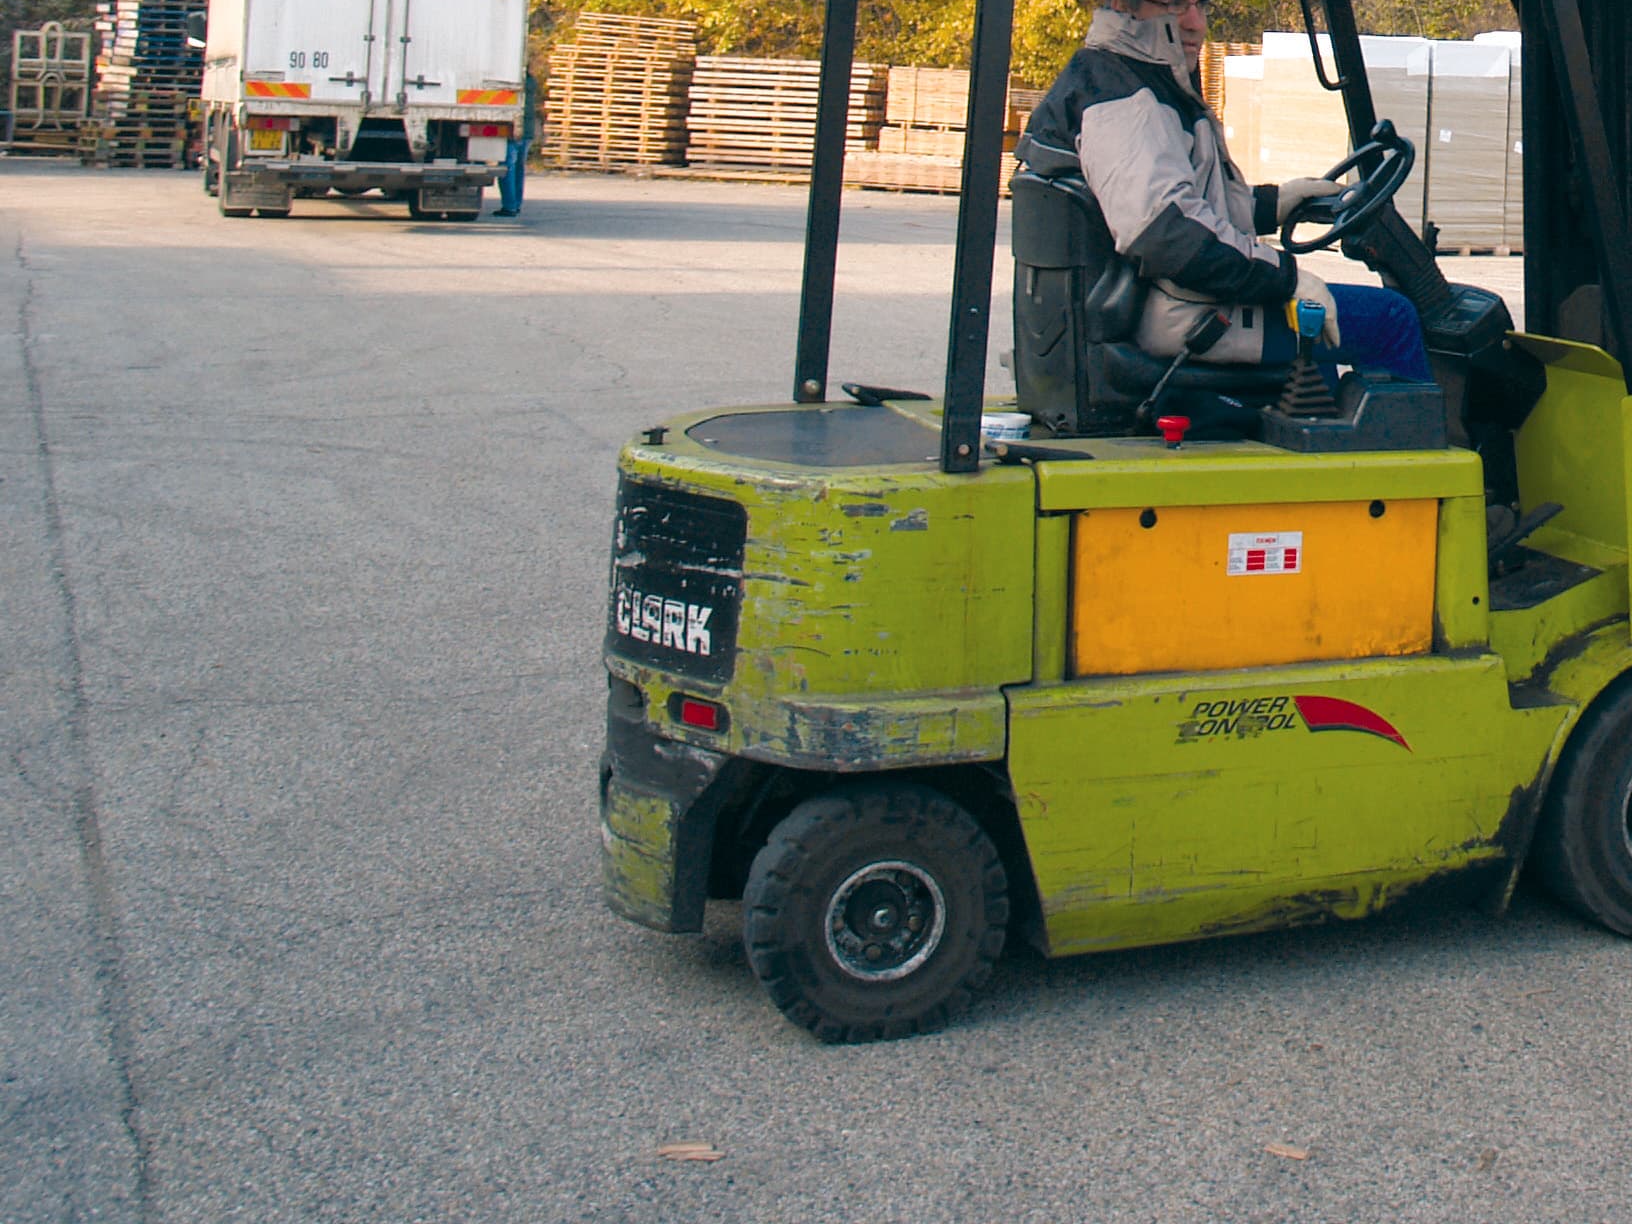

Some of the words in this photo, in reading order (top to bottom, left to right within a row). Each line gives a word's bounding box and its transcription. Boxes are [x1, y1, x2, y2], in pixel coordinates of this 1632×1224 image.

[289, 50, 306, 69] 90
[312, 50, 329, 69] 80
[617, 587, 713, 656] CLARK
[1192, 696, 1290, 719] POWER
